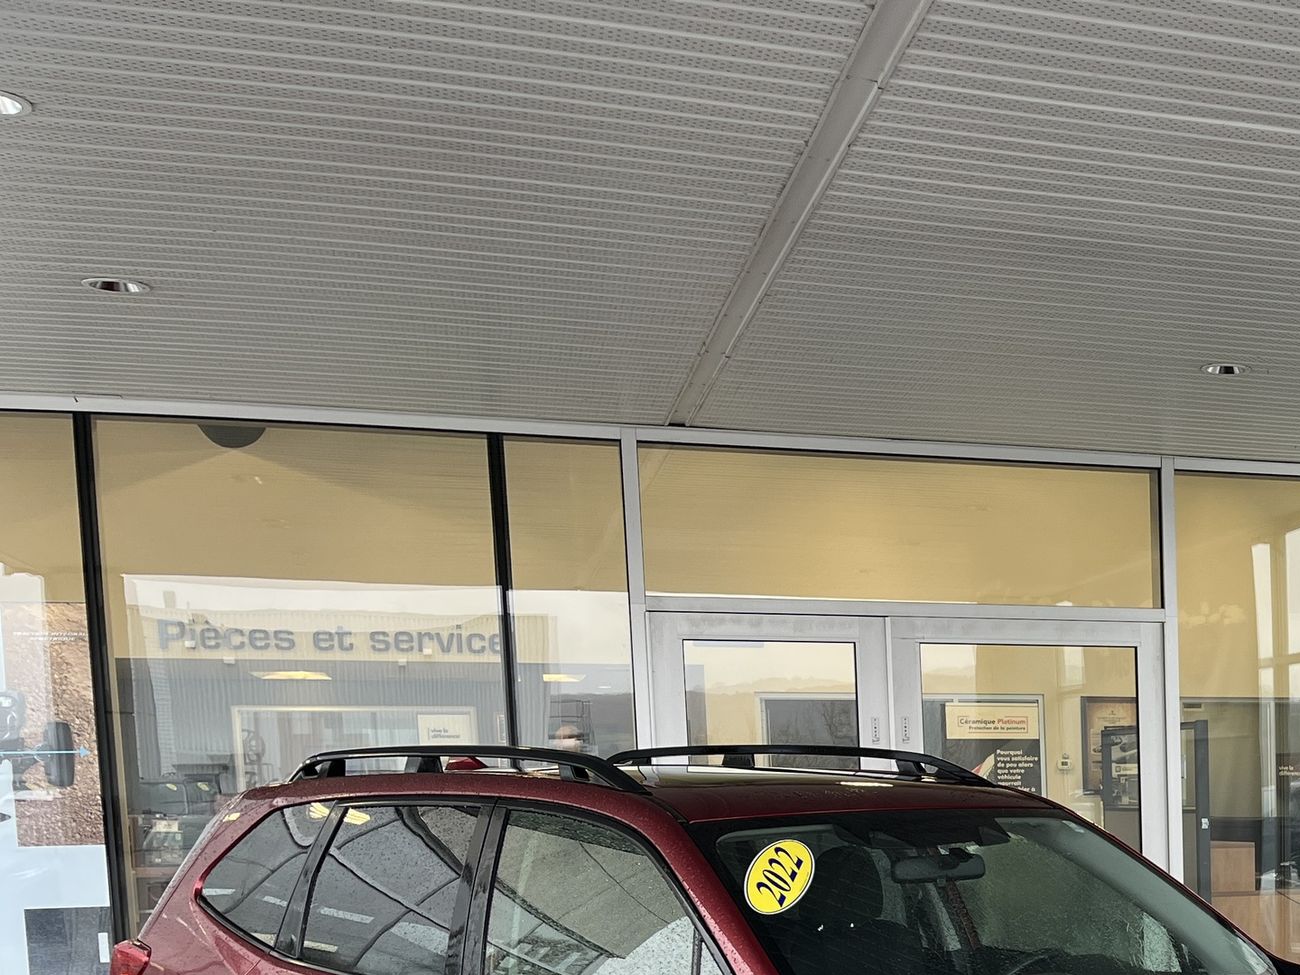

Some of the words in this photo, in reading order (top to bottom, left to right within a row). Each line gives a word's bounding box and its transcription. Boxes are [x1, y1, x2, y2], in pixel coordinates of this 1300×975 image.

[312, 626, 355, 652] et
[960, 718, 996, 726] Céramique
[756, 846, 803, 907] 2022
